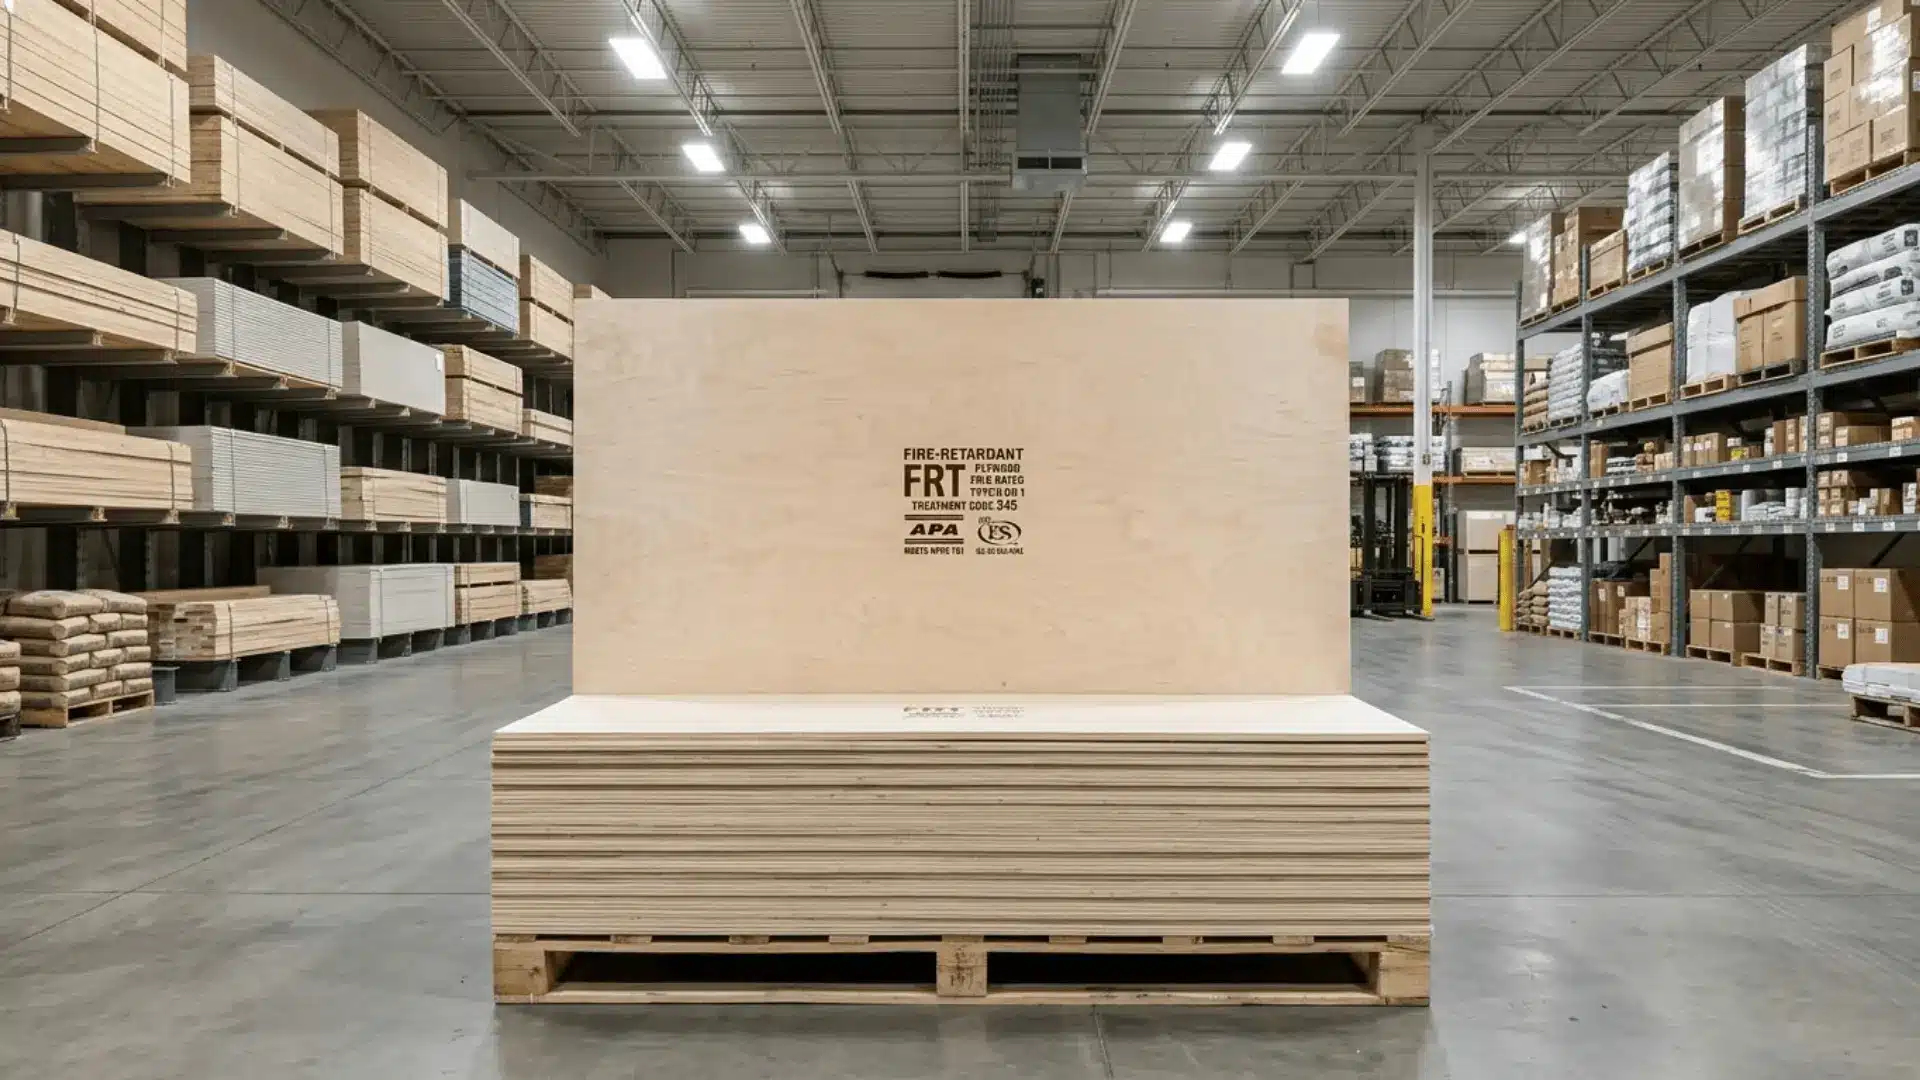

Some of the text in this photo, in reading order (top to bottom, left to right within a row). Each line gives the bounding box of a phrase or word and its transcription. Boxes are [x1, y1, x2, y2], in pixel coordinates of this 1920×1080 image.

[903, 447, 1025, 461] FIRE-RETARDANT
[904, 463, 966, 497] FRT
[996, 500, 1019, 511] 345
[909, 523, 959, 536] APA
